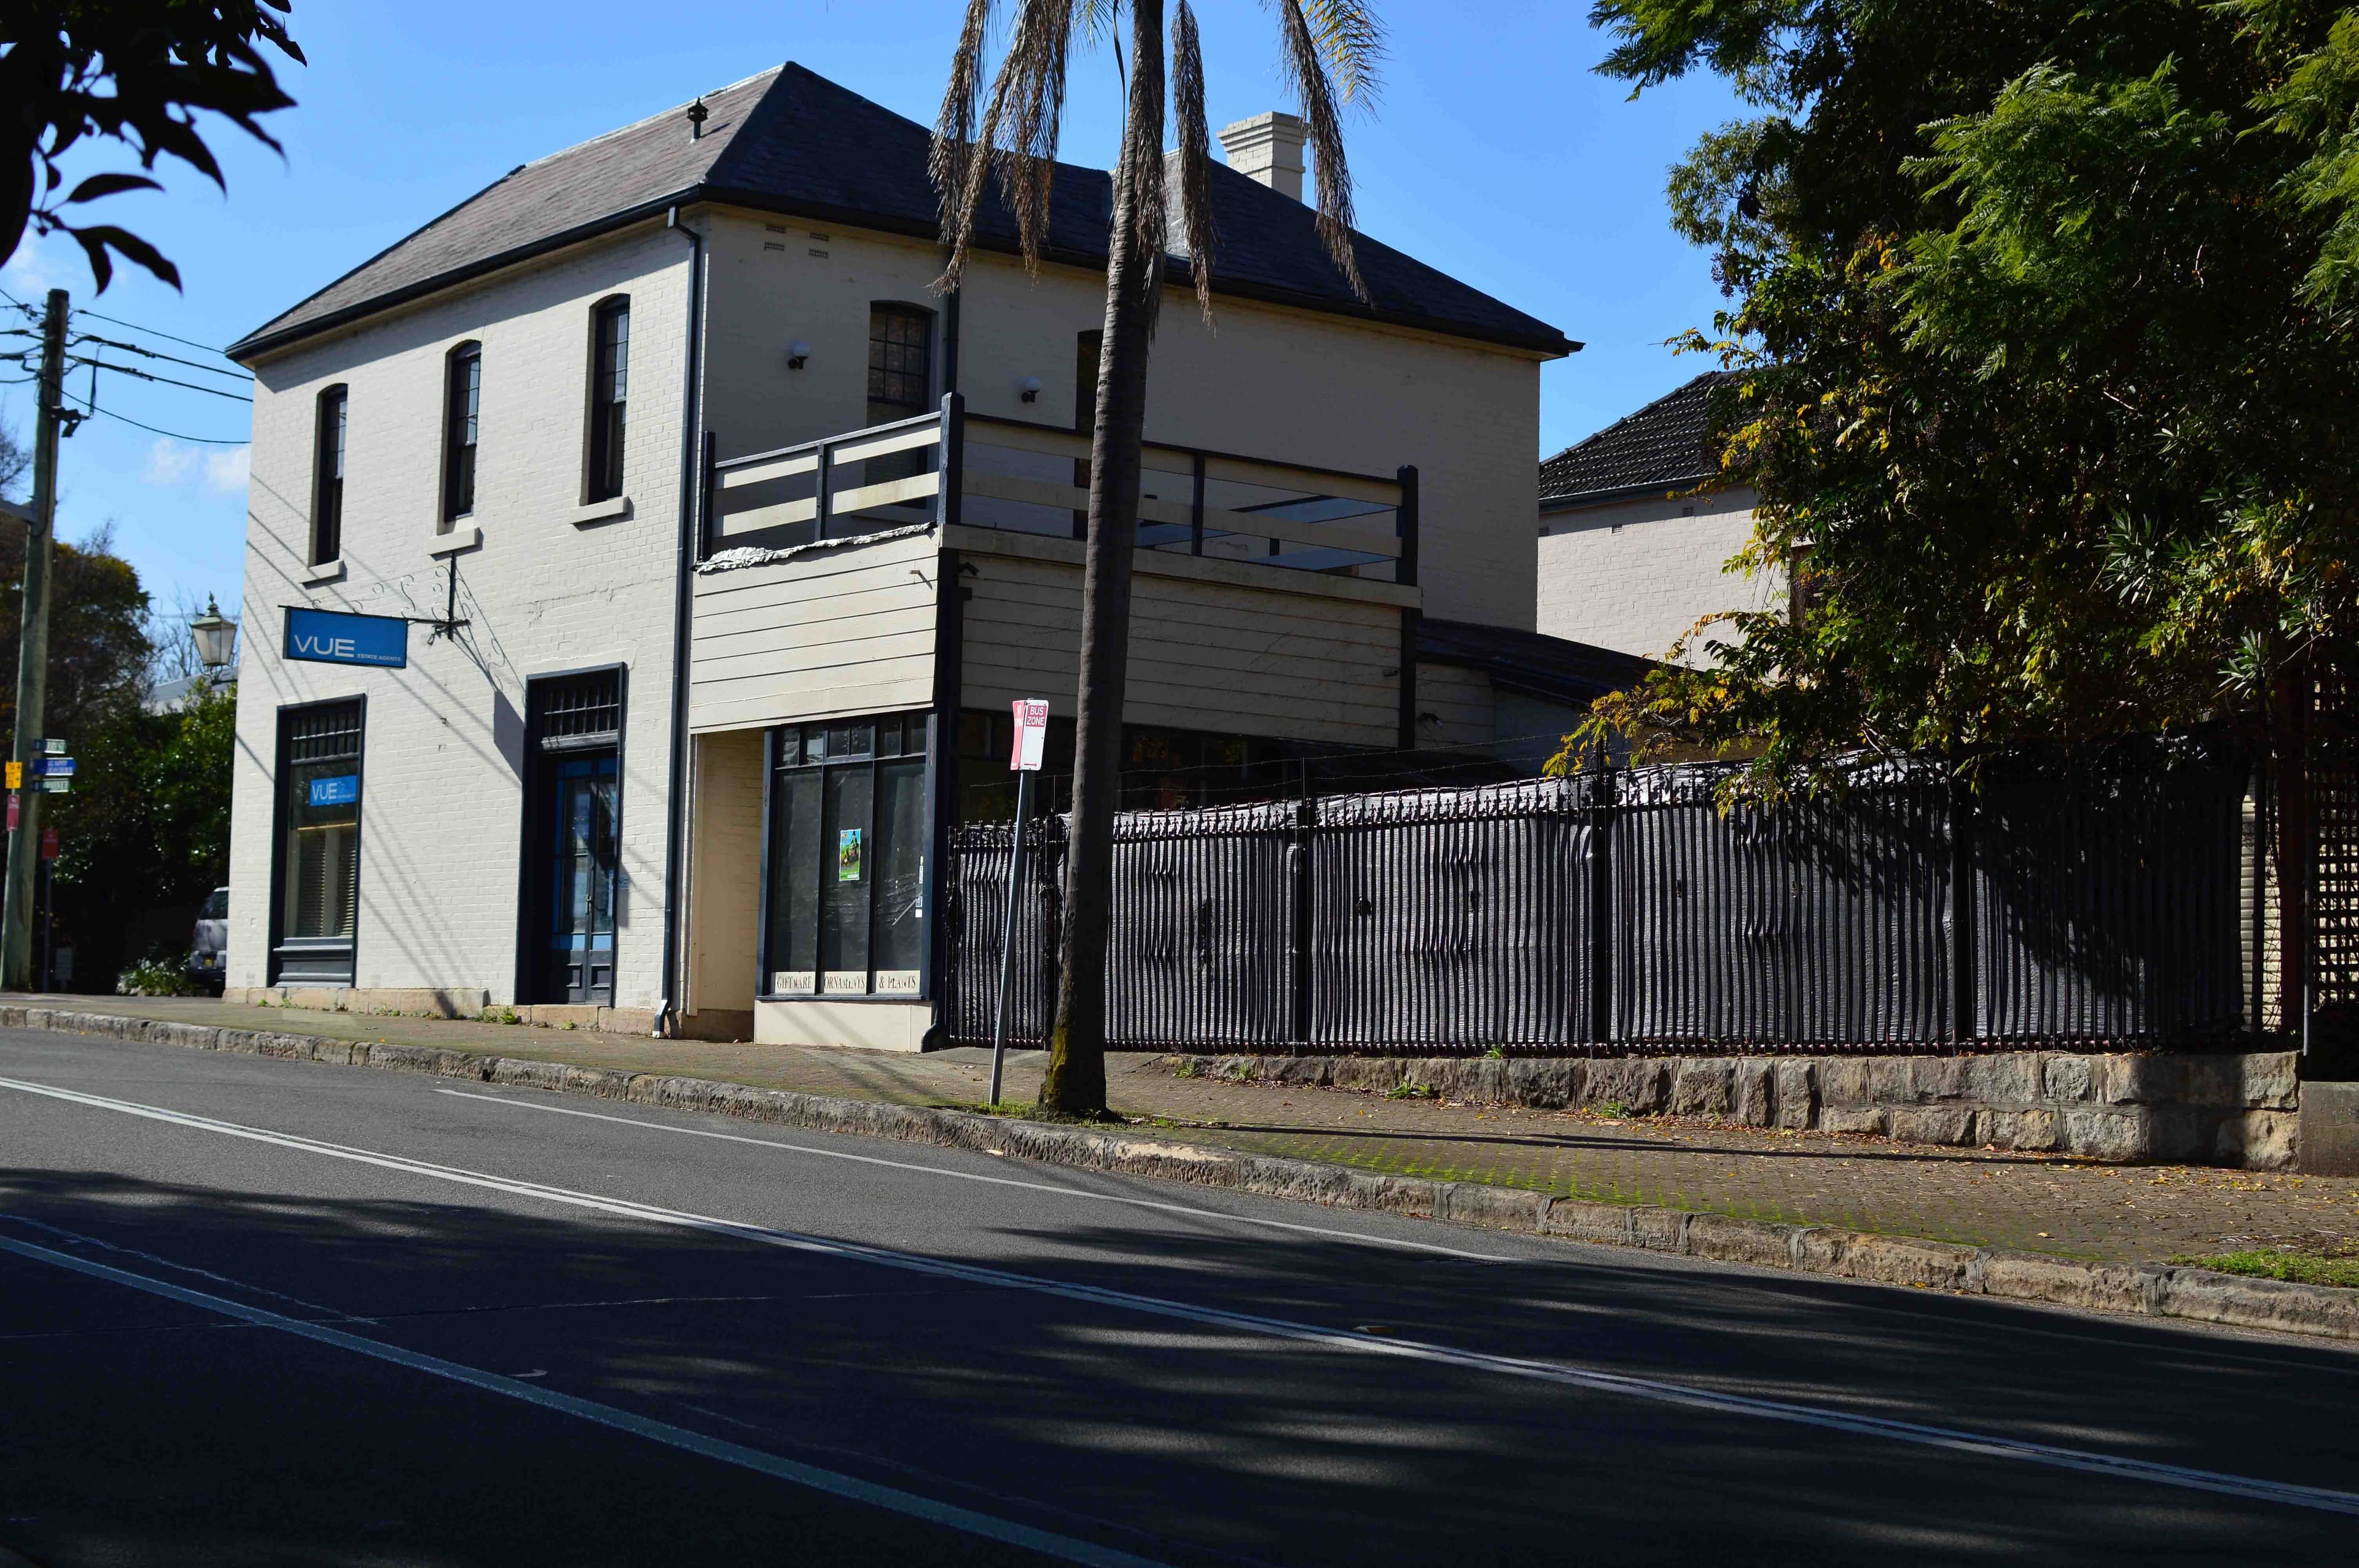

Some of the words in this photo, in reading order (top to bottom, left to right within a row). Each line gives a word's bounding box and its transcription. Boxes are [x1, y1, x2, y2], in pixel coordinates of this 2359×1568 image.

[294, 634, 355, 658] VUE
[1030, 706, 1044, 715] BUS
[1027, 716, 1044, 725] ZONE
[311, 782, 338, 801] VUE
[777, 975, 812, 989] GIFTWARE
[824, 975, 865, 989] ORNAMENTS
[878, 975, 885, 988] &
[888, 975, 916, 989] PLANTS
